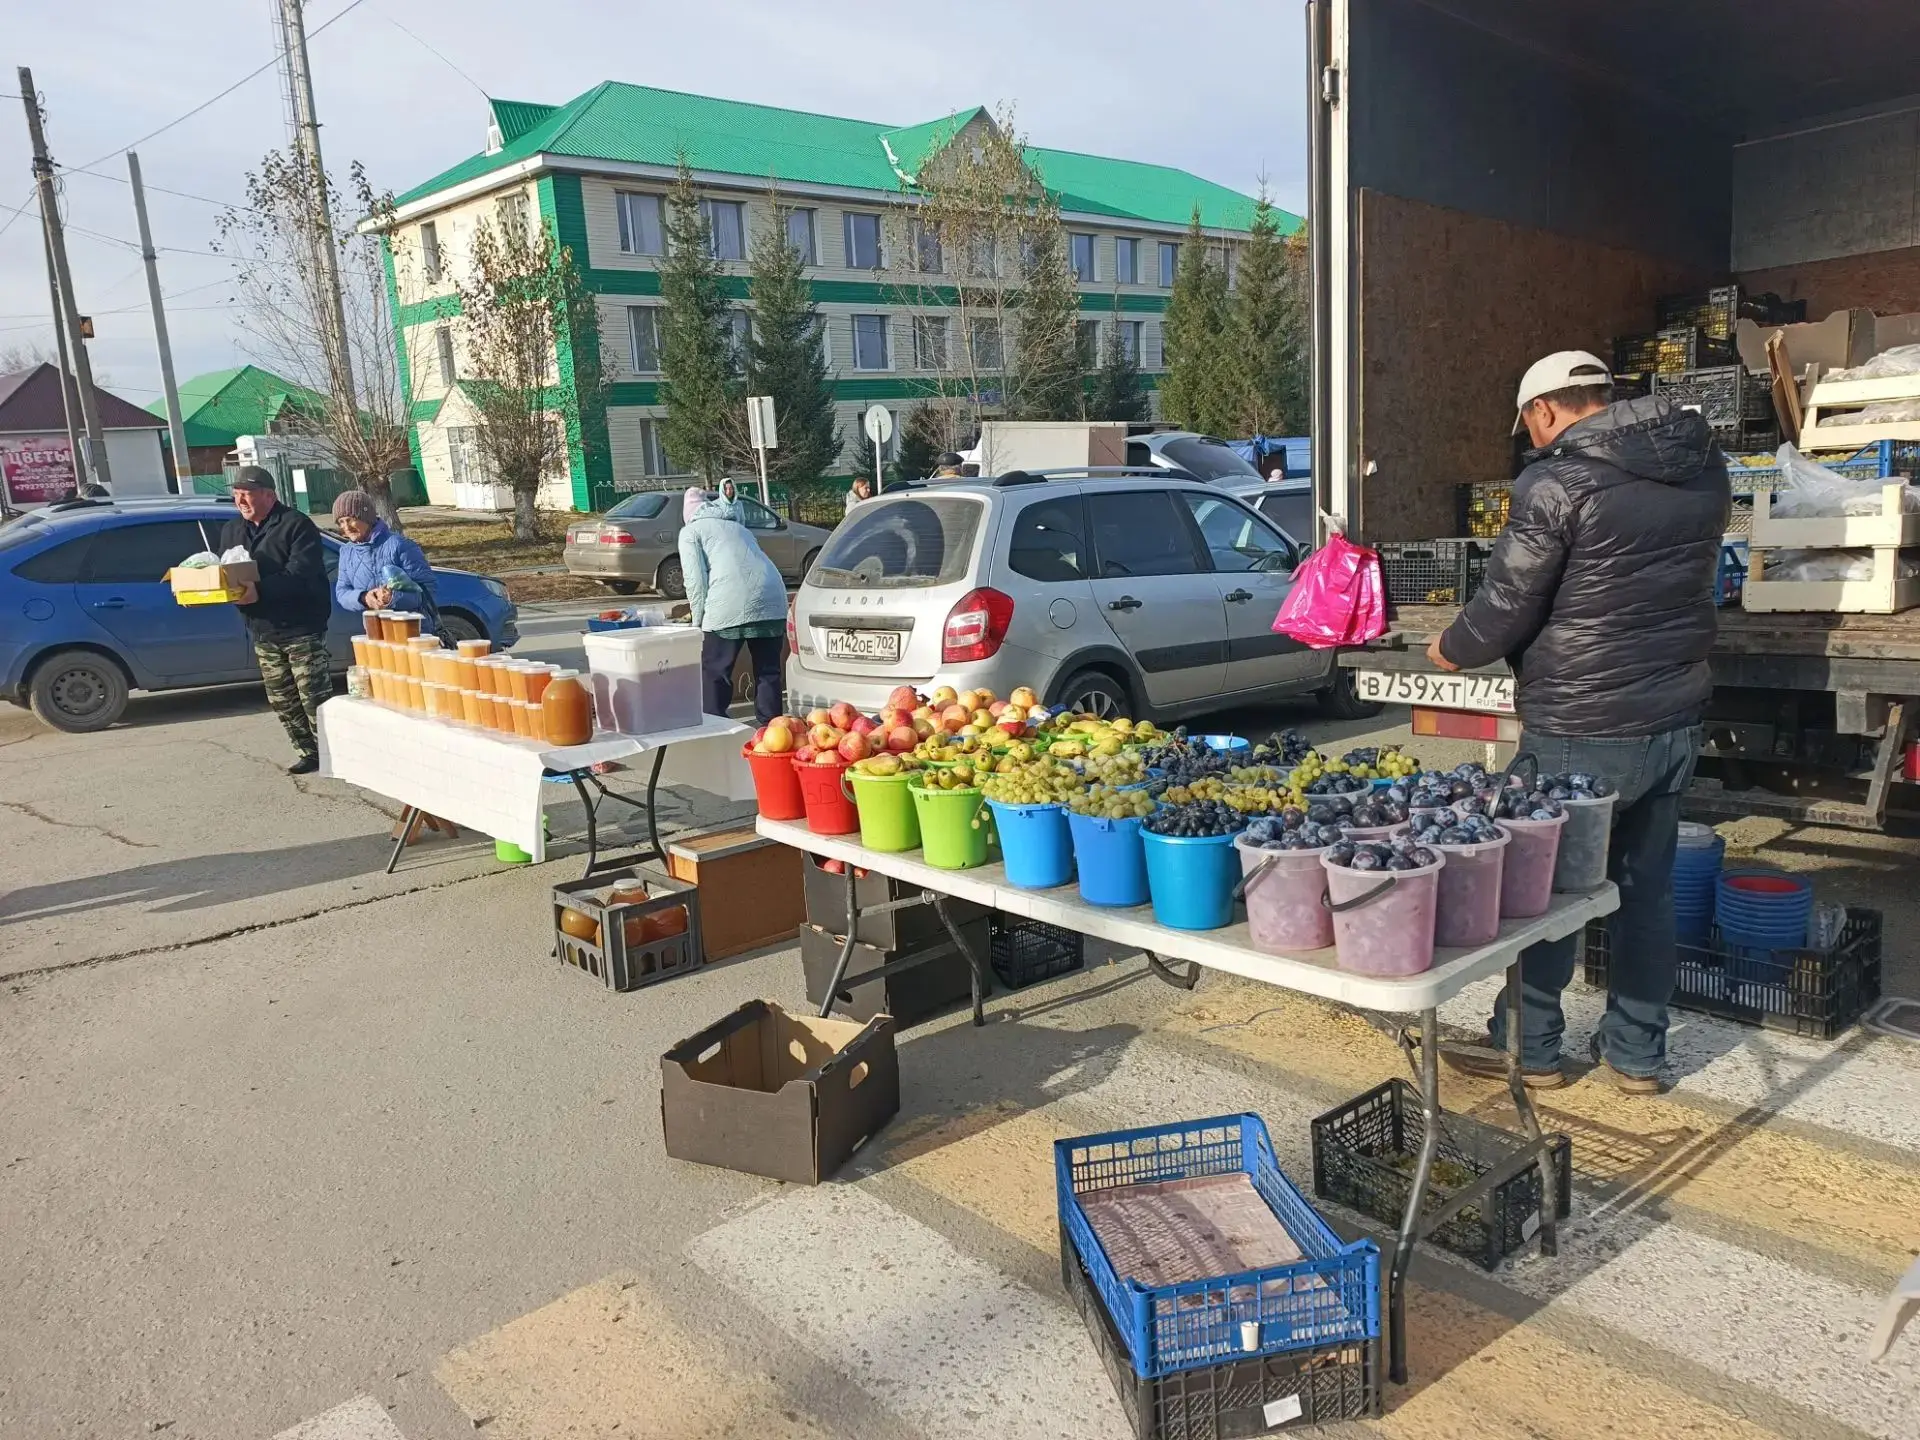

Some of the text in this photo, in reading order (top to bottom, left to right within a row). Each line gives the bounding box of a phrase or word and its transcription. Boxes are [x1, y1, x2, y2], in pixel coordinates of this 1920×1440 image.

[8, 450, 70, 466] ЦВЕТЫ
[832, 596, 884, 605] LADA
[830, 635, 873, 654] М142ОЕ
[876, 636, 895, 650] 702
[1367, 671, 1507, 703] В759ХТ 774
[1476, 699, 1497, 708] RUS
